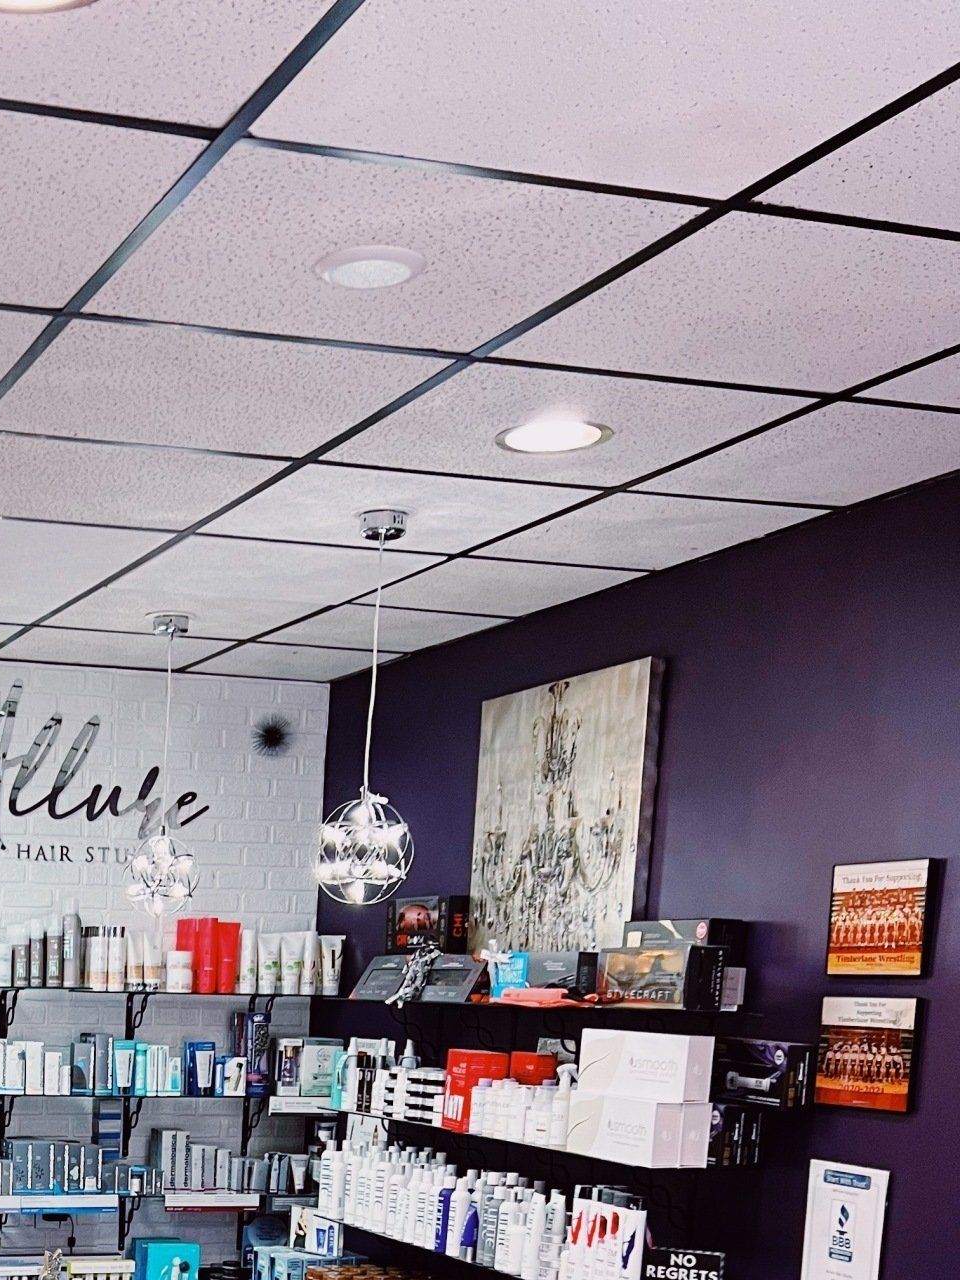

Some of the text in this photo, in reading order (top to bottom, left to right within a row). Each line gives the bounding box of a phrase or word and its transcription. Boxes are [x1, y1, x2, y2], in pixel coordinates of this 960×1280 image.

[16, 843, 74, 863] HAIR
[606, 989, 672, 1001] STYLECRAFT
[169, 1134, 177, 1187] dermalogica
[183, 1134, 191, 1188] dermalogica
[832, 1235, 851, 1249] BBB
[670, 1253, 697, 1268] NO
